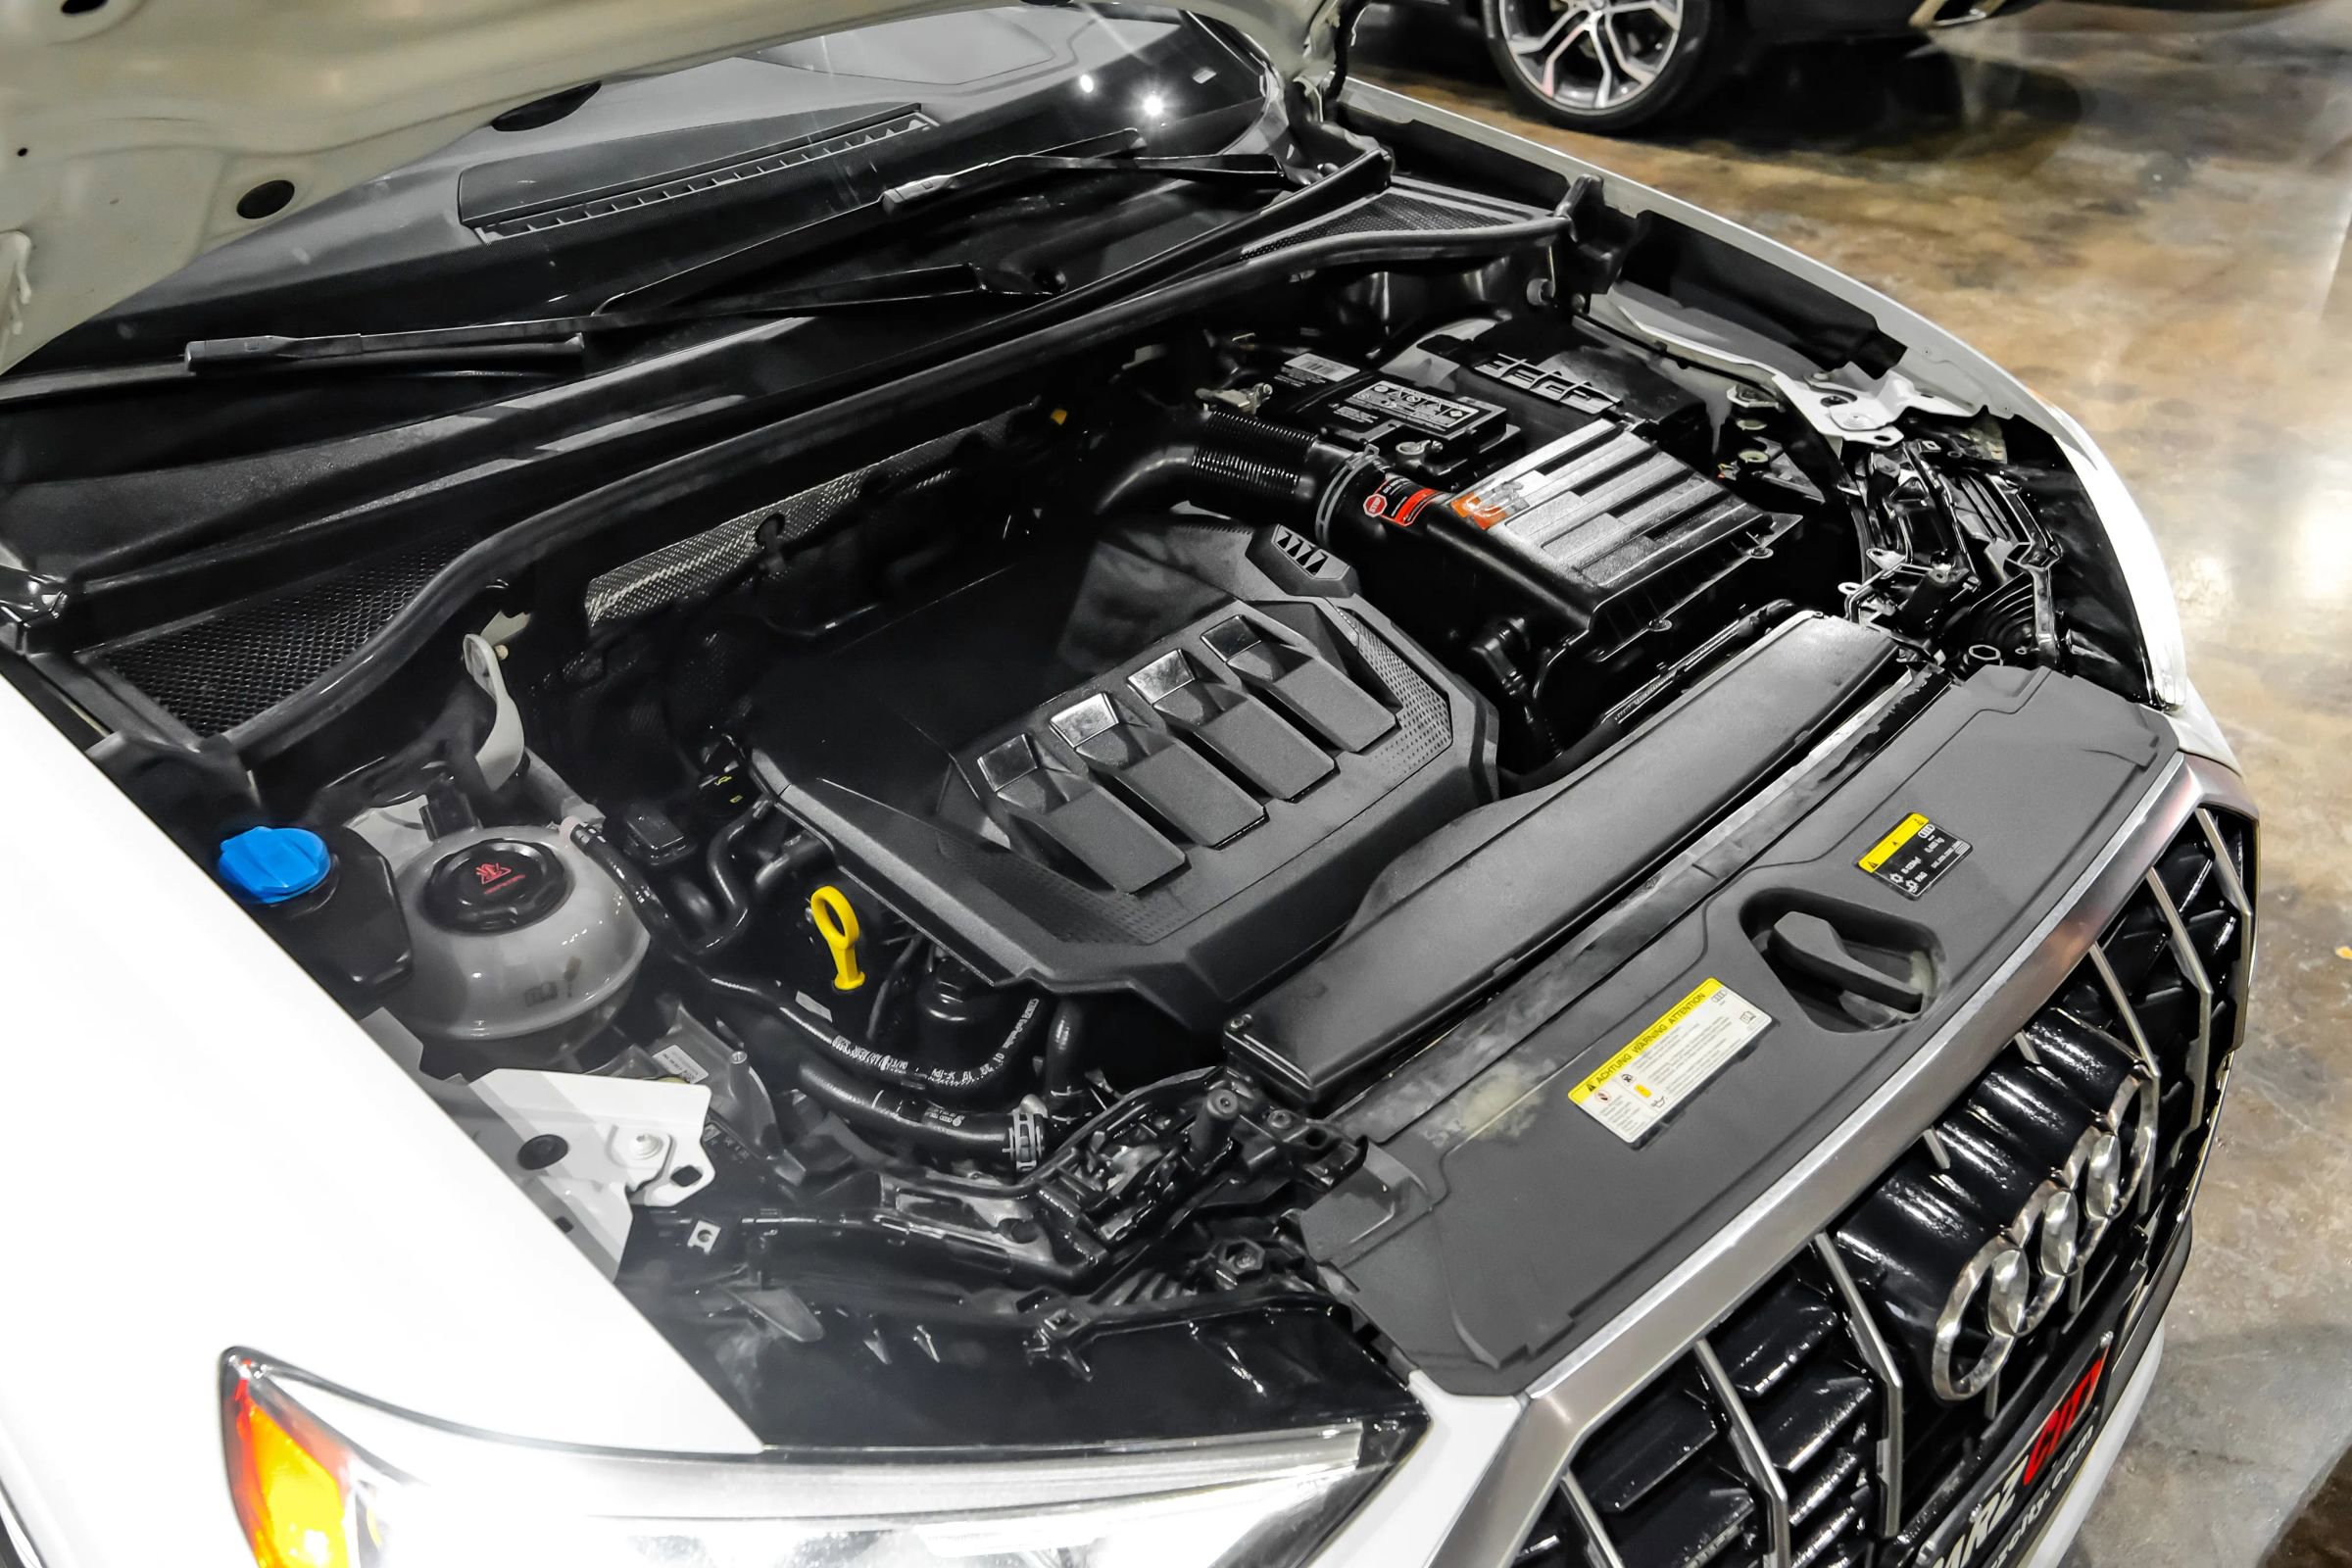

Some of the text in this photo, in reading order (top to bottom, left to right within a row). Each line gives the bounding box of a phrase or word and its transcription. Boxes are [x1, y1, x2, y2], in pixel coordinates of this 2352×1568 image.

[1595, 992, 1706, 1084] ACHTUNG WARNING ATTENTION
